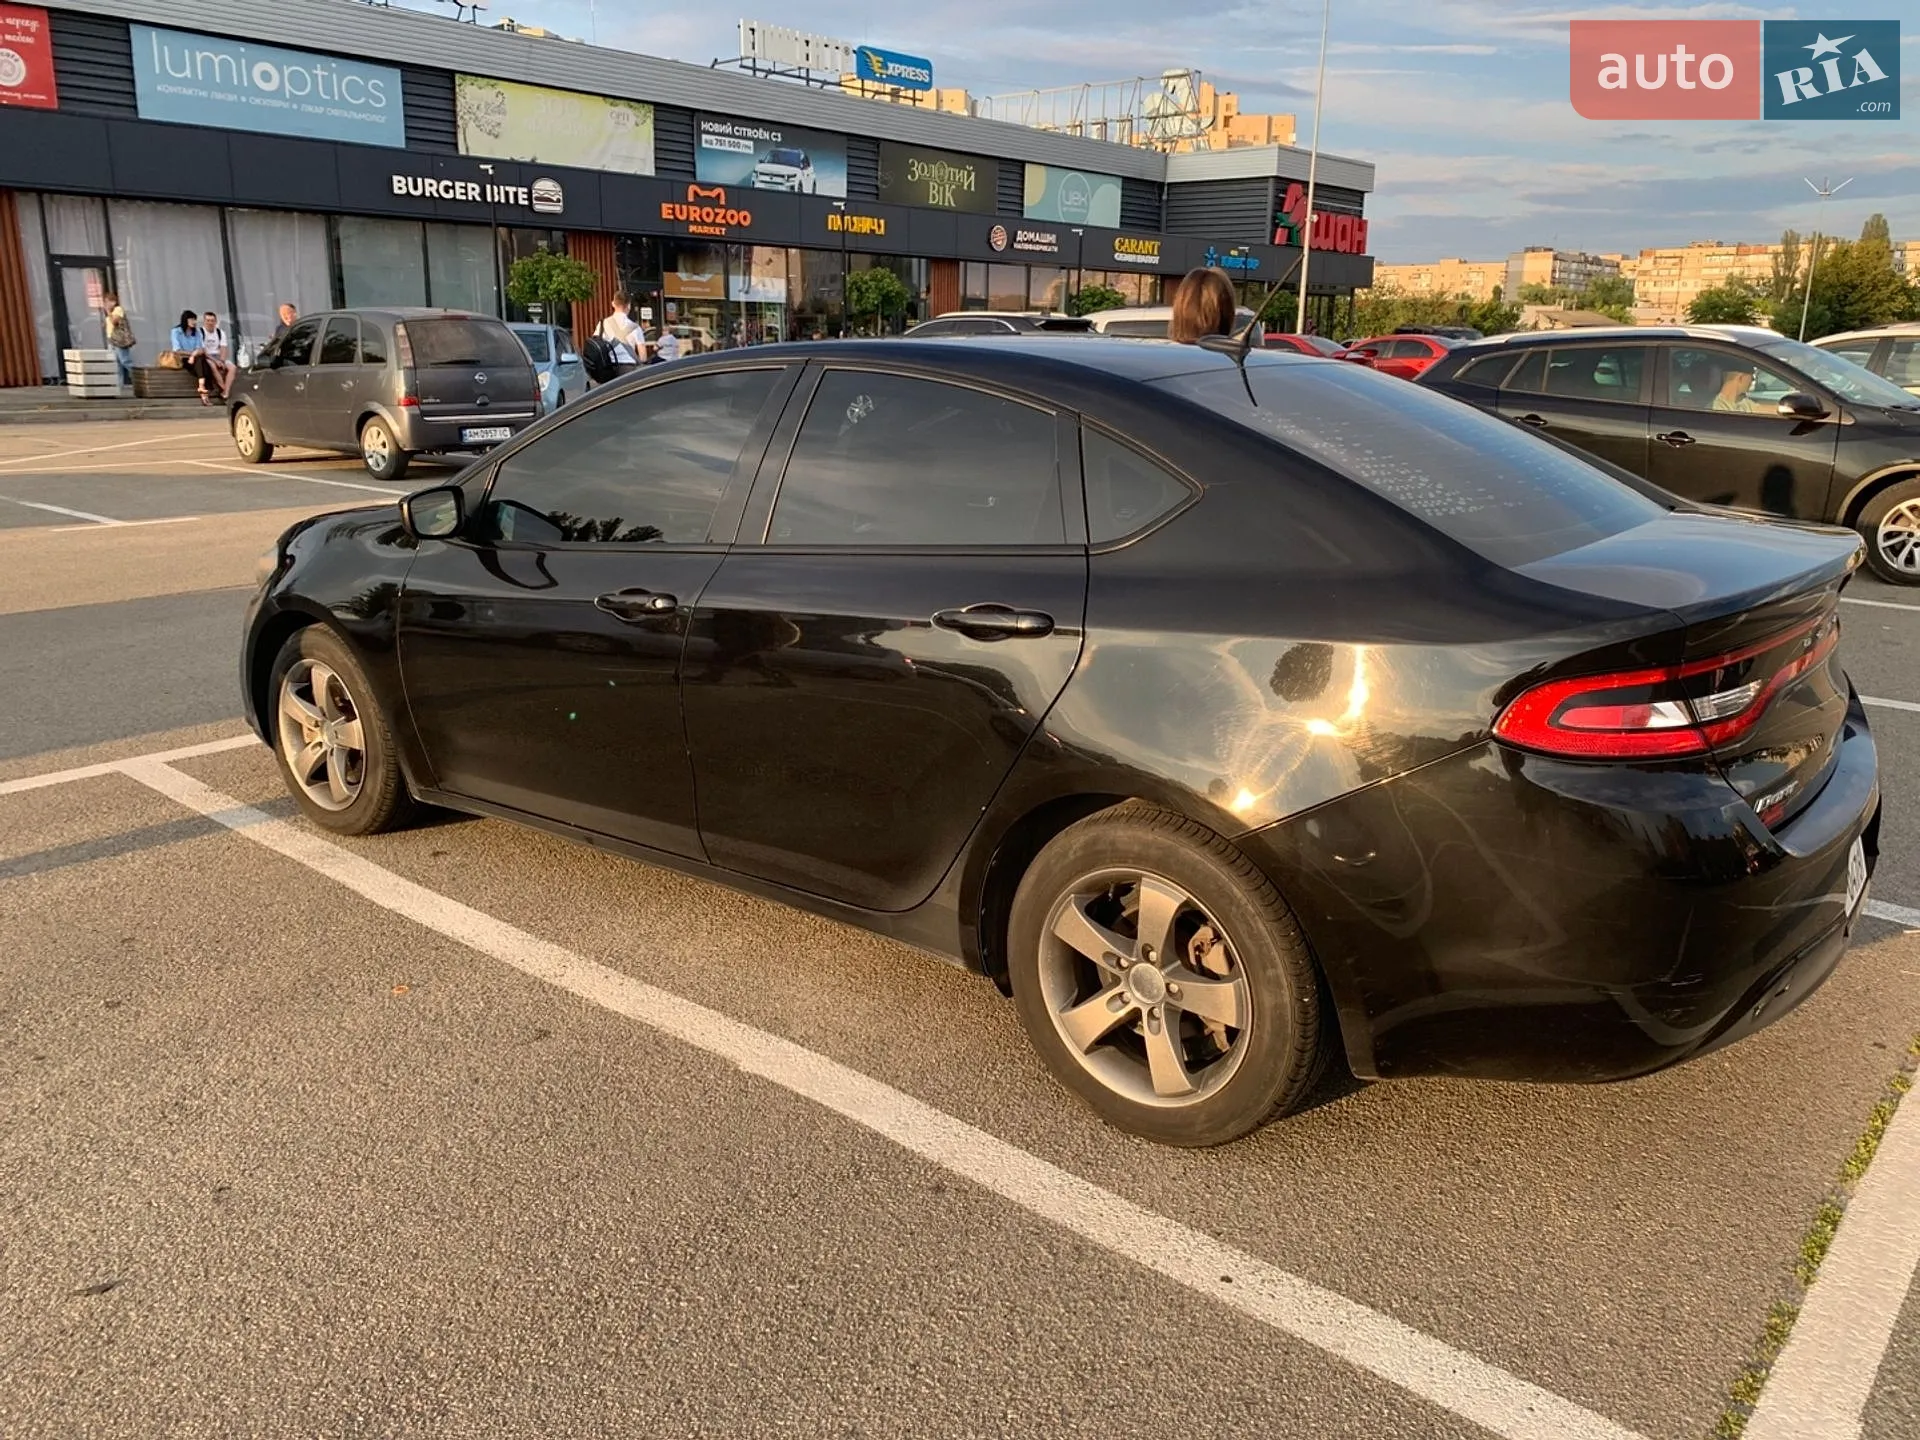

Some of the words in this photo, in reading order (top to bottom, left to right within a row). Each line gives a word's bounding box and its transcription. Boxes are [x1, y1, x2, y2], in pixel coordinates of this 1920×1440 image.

[151, 31, 387, 108] lumioptics
[870, 56, 930, 83] EXPRESS
[701, 121, 732, 135] НОВИЙ
[392, 175, 481, 203] BURGER
[485, 183, 529, 207] BITE
[661, 203, 751, 227] EUROZOO
[688, 225, 727, 236] MARKET
[1015, 230, 1057, 244] ДОМАШНІ
[1113, 237, 1161, 255] GARANT
